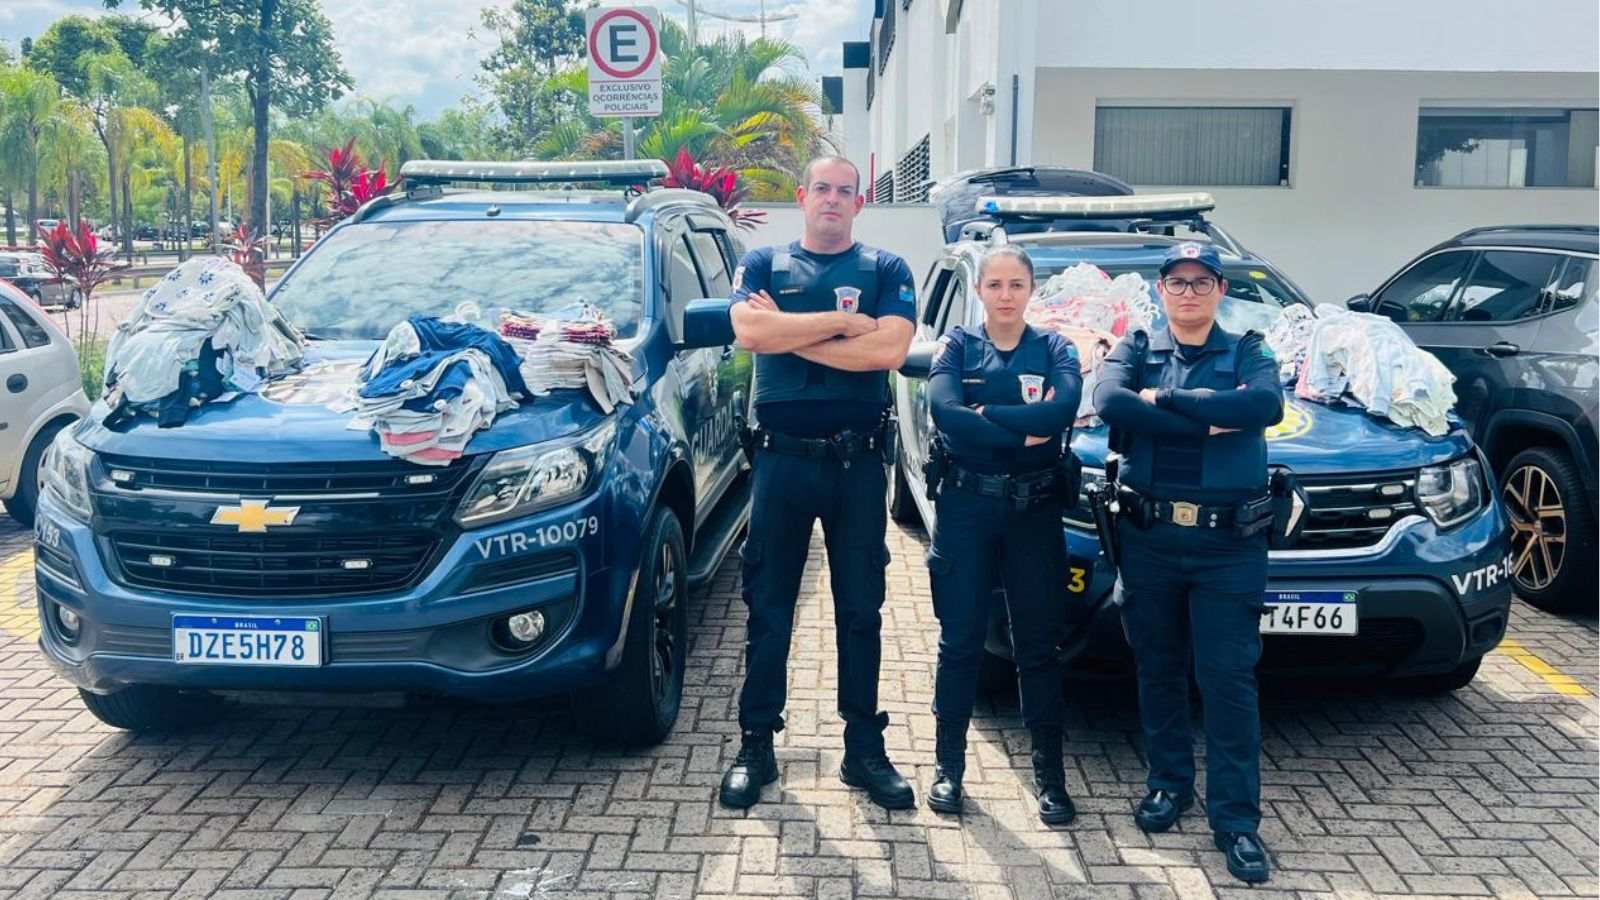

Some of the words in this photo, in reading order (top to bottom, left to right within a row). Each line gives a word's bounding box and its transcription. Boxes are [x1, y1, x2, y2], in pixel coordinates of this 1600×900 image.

[609, 25, 639, 62] E
[600, 83, 652, 92] EXCLUSIVO
[592, 92, 658, 103] OCORRÊNCIAS
[604, 103, 649, 112] POLICIAIS
[474, 515, 599, 559] VTR-10079
[188, 632, 305, 660] DZE5H78
